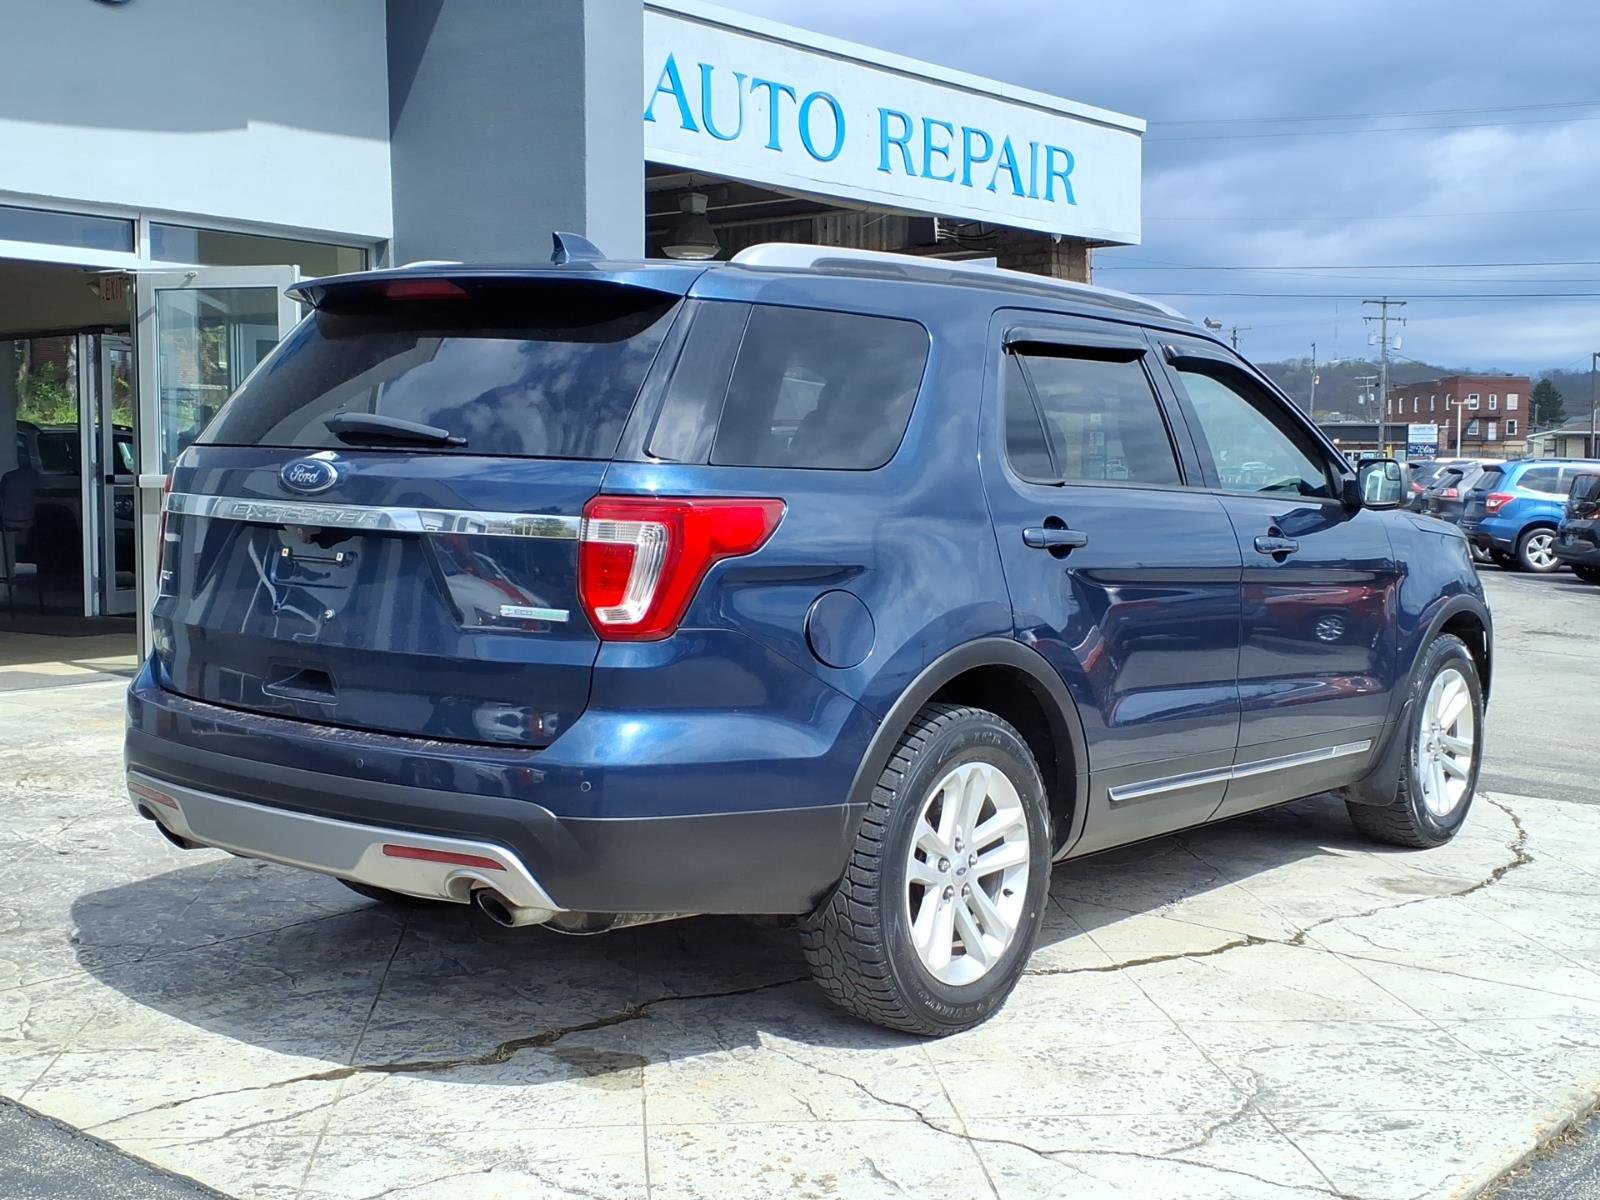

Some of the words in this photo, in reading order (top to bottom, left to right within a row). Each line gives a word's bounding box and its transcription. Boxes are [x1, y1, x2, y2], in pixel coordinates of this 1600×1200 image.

[644, 52, 847, 162] AUTO
[877, 107, 1078, 206] REPAIR
[290, 463, 321, 483] Ford
